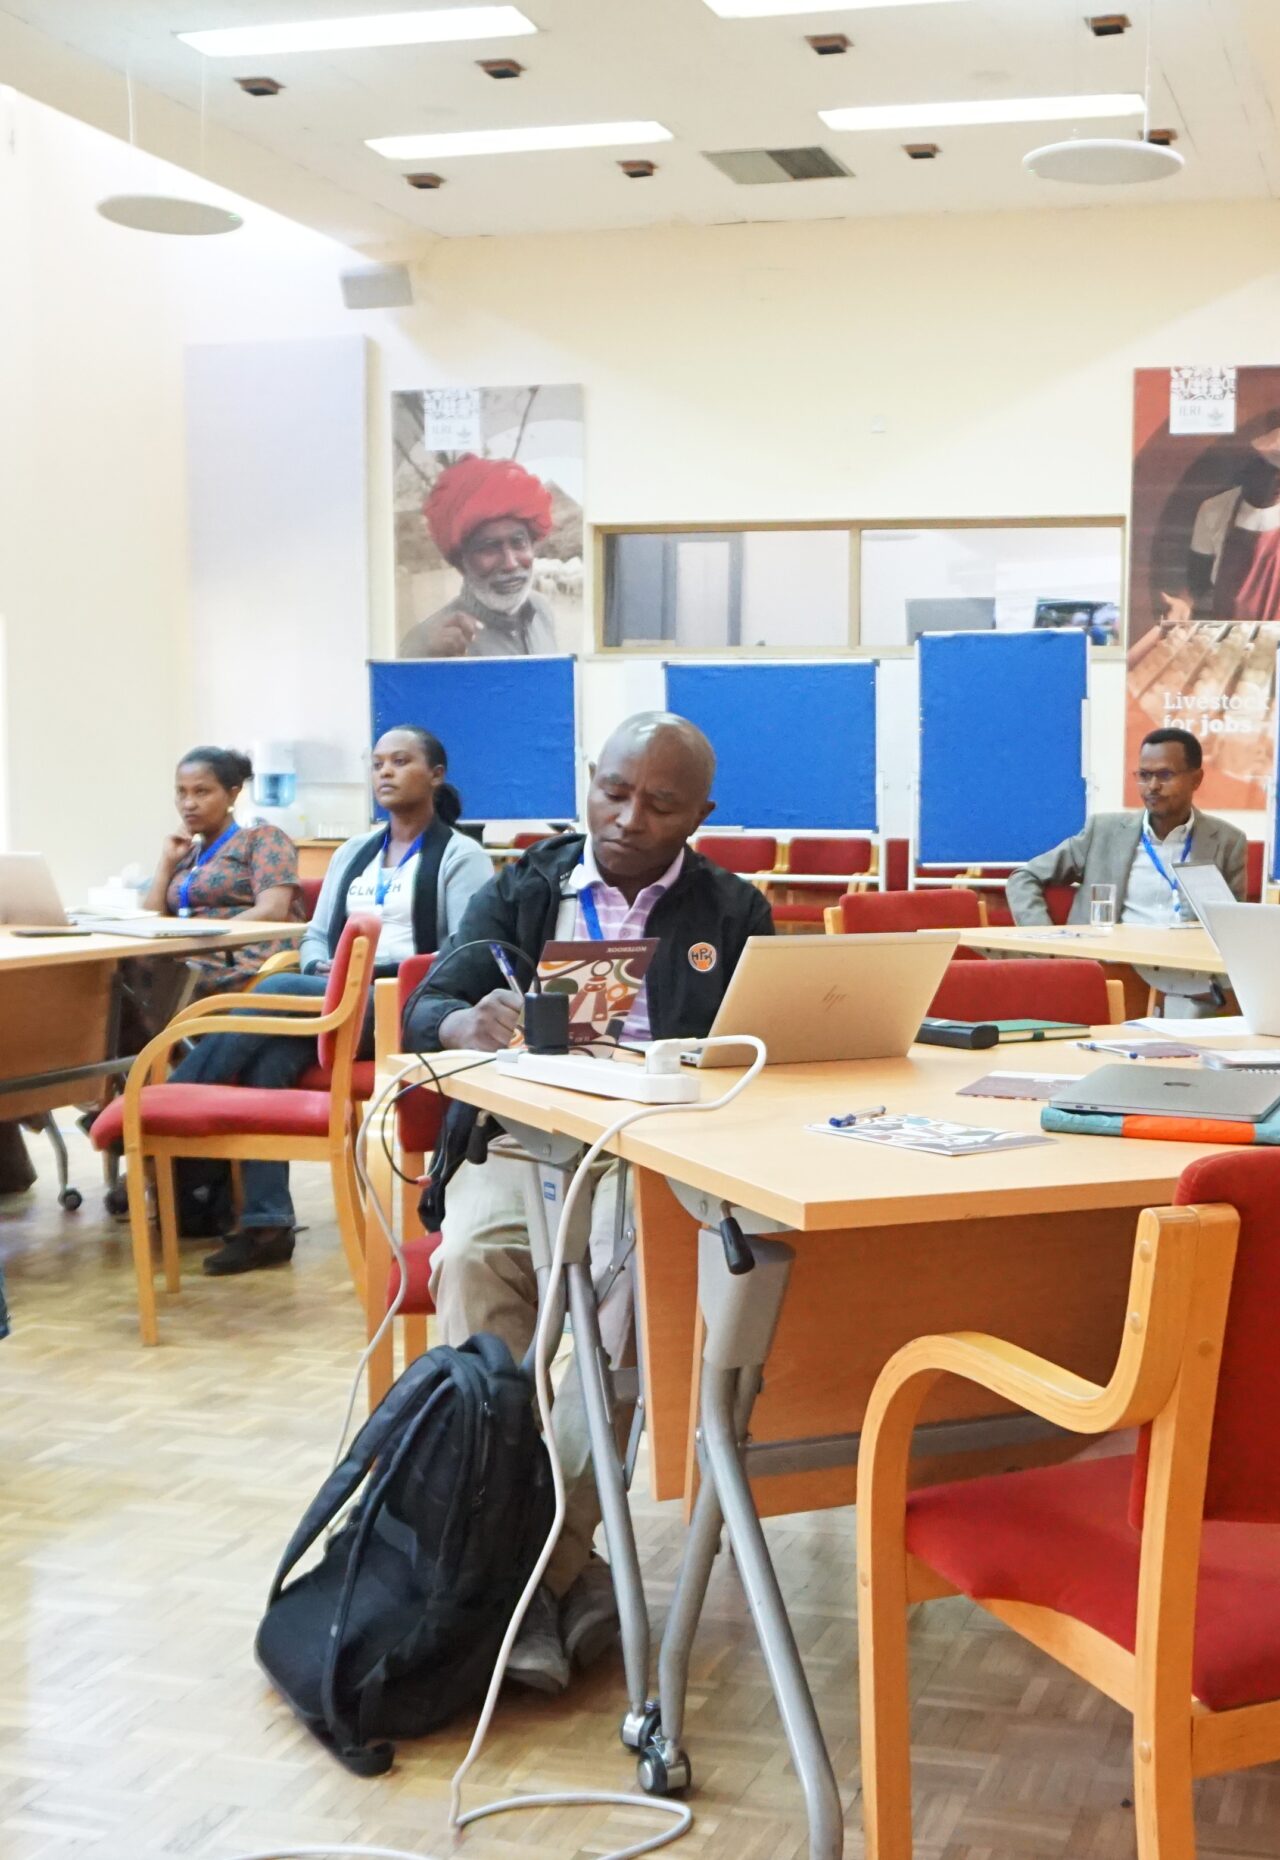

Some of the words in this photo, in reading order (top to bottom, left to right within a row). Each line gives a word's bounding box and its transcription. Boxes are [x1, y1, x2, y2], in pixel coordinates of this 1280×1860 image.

[1162, 691, 1270, 710] Livestock
[1162, 714, 1196, 732] for
[1199, 713, 1254, 737] jobs
